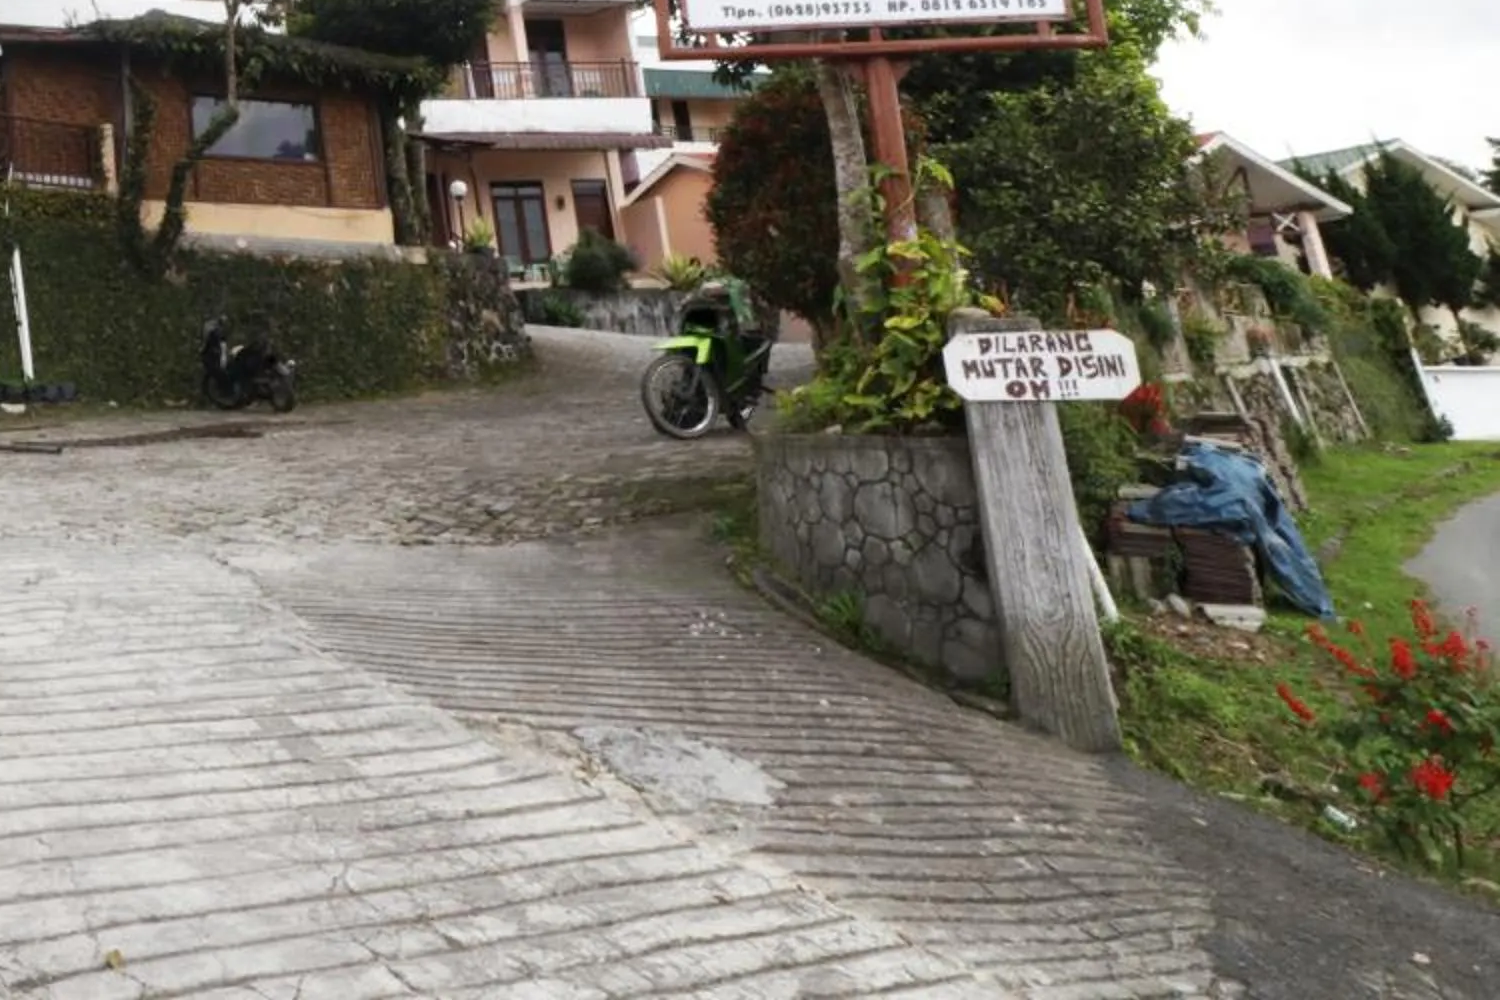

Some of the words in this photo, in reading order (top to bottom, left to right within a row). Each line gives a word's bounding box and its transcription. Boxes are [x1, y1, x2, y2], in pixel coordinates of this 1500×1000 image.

[977, 333, 1093, 355] DILARANG
[961, 358, 1049, 380] MUTAR
[1056, 354, 1127, 379] DISINI
[1005, 379, 1050, 400] OM
